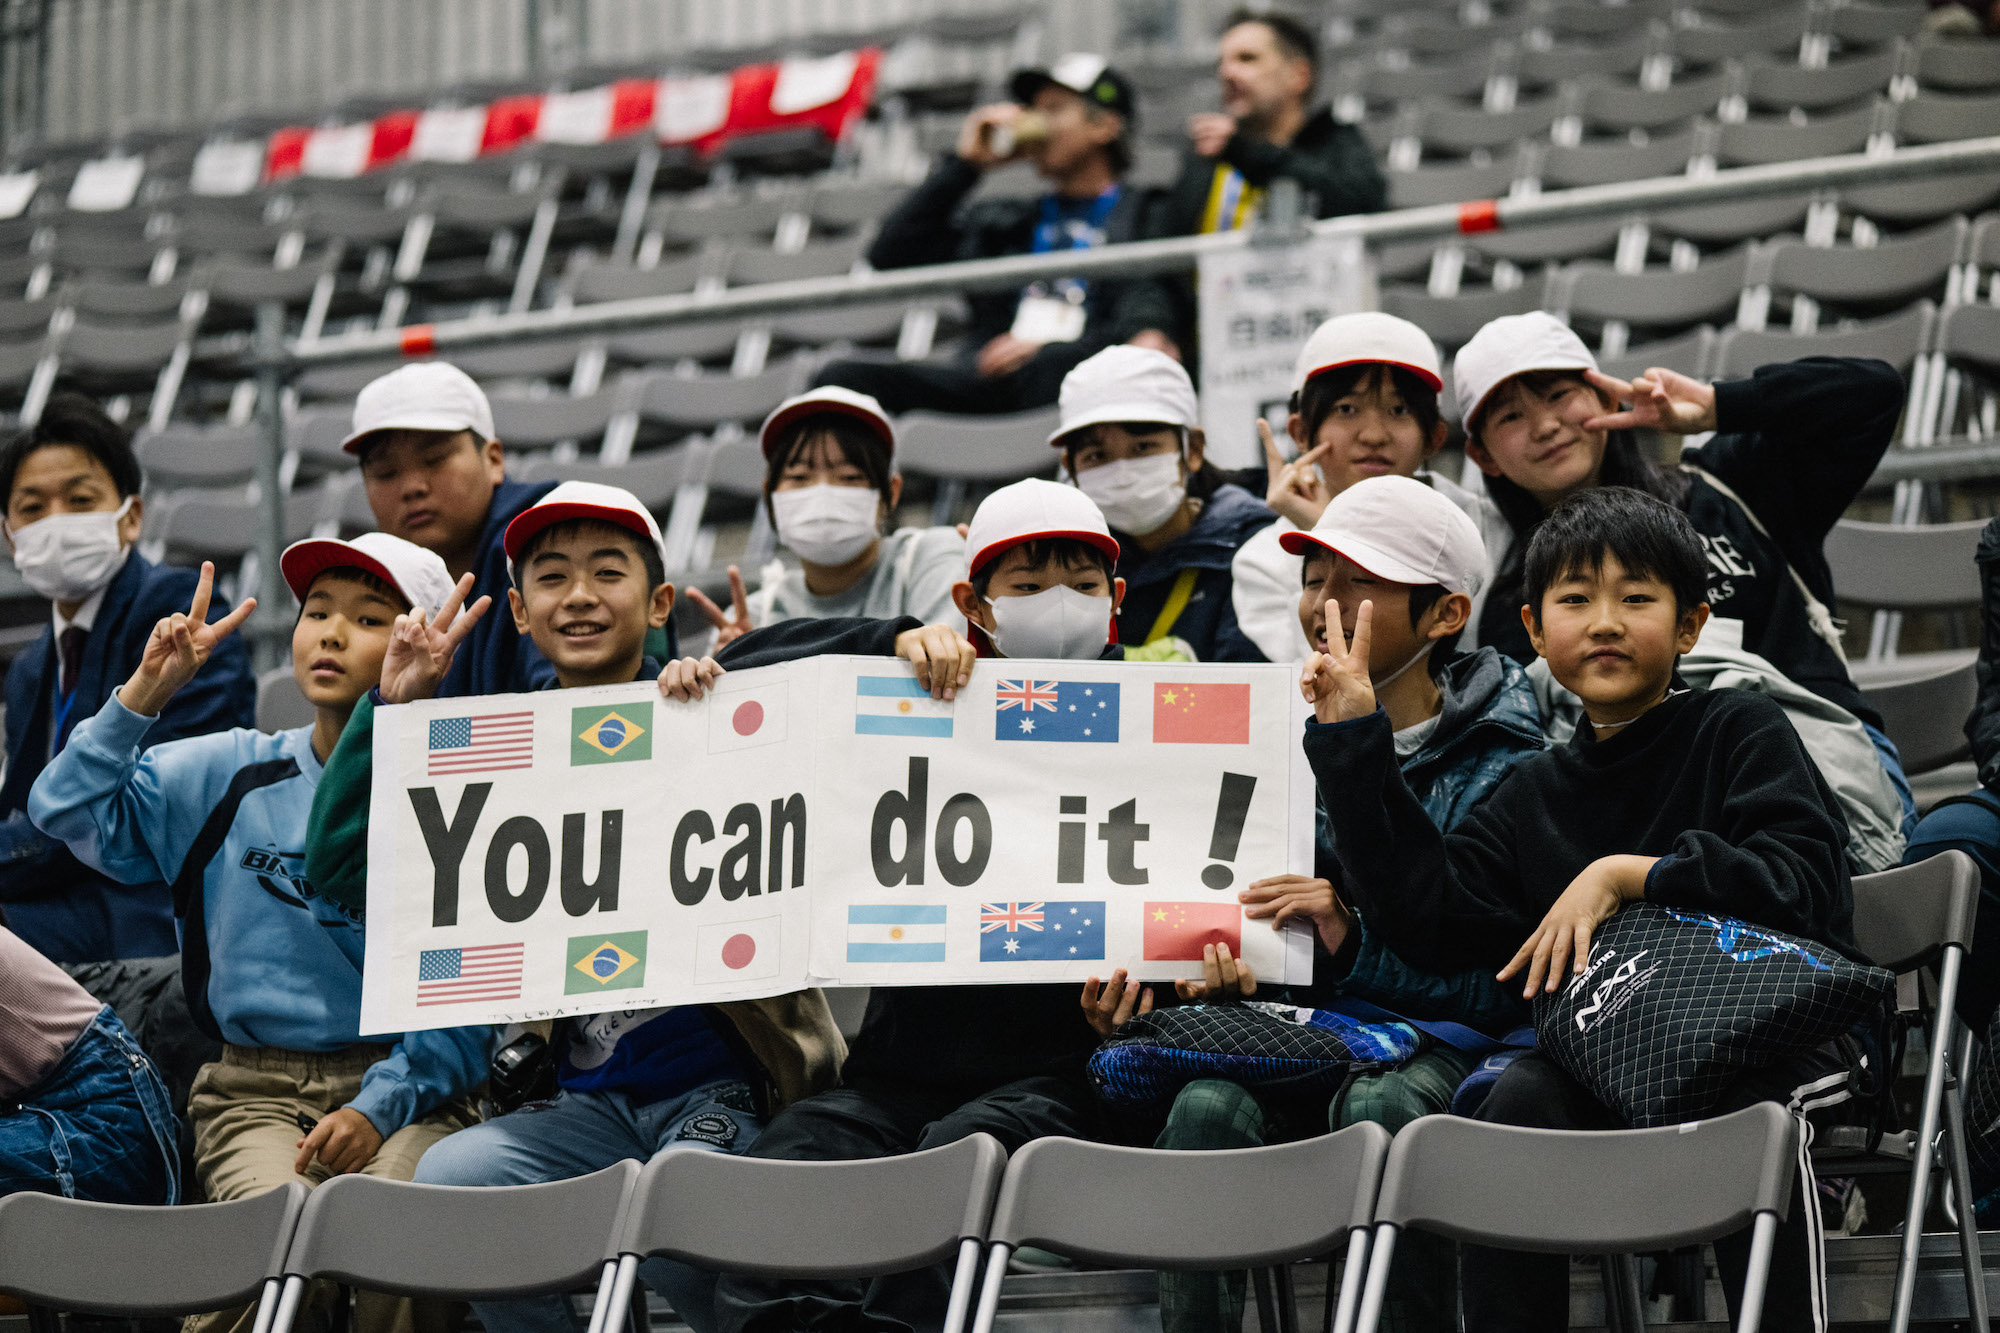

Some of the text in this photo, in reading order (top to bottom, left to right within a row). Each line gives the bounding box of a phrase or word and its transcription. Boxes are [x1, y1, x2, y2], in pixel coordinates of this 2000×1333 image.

[407, 782, 624, 928] You
[670, 792, 807, 906] can
[870, 756, 993, 888] do
[1057, 796, 1150, 886] it
[1201, 771, 1258, 890] !
